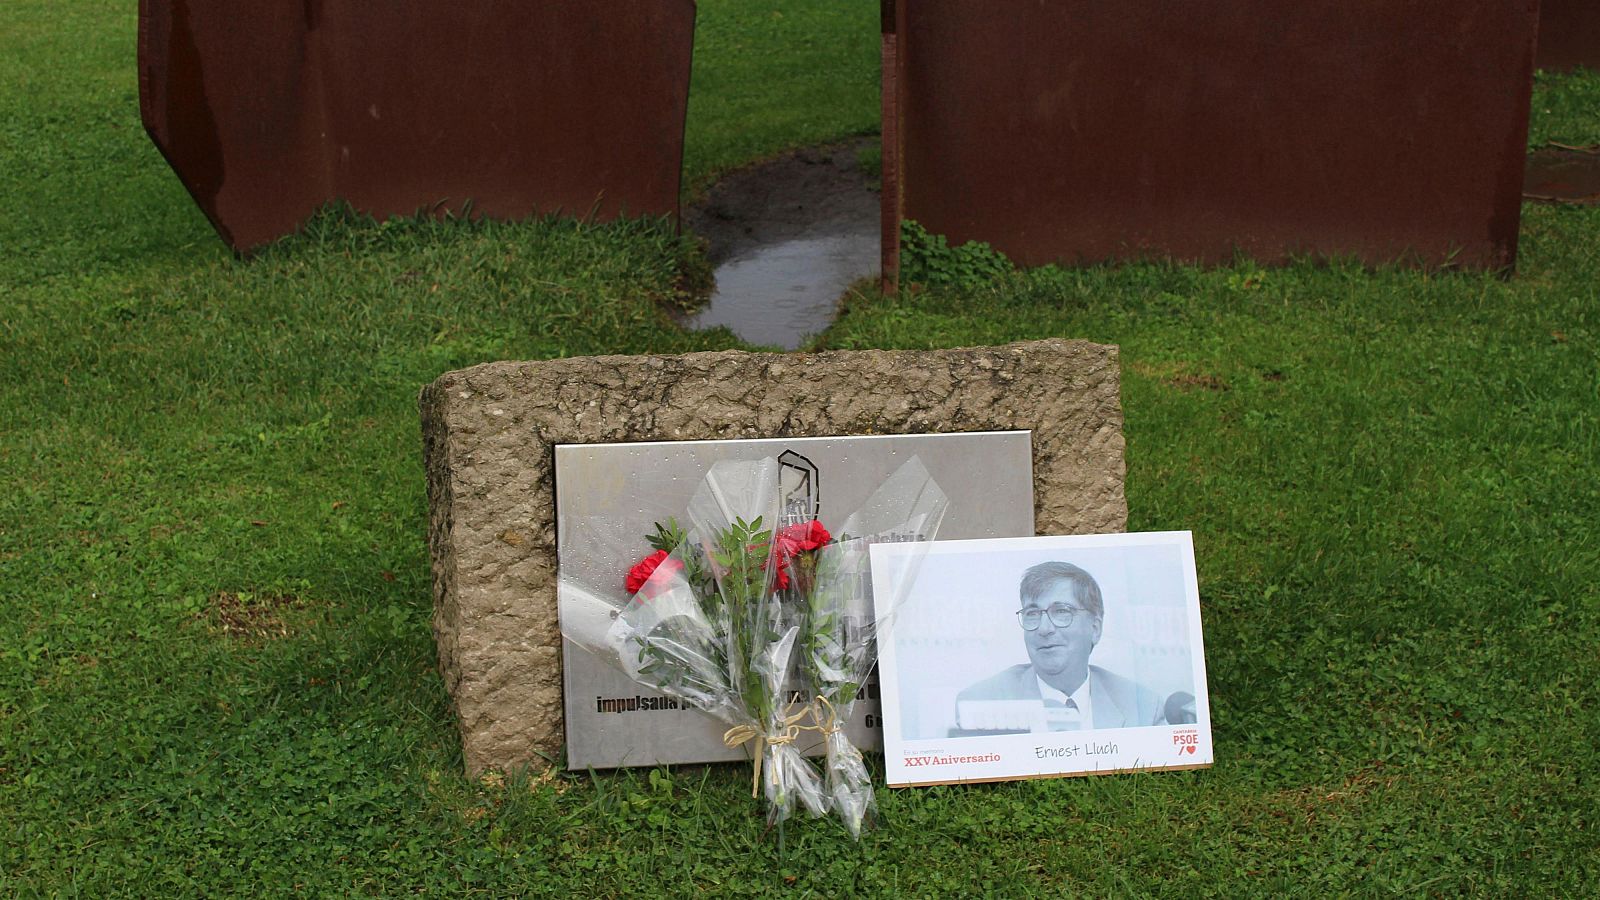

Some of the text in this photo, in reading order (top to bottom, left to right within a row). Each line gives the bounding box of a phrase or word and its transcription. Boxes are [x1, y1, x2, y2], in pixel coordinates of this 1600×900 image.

[1173, 734, 1199, 745] PSOE
[1034, 741, 1119, 759] Ernest Lluch
[904, 752, 1001, 767] XXV Aniversario
